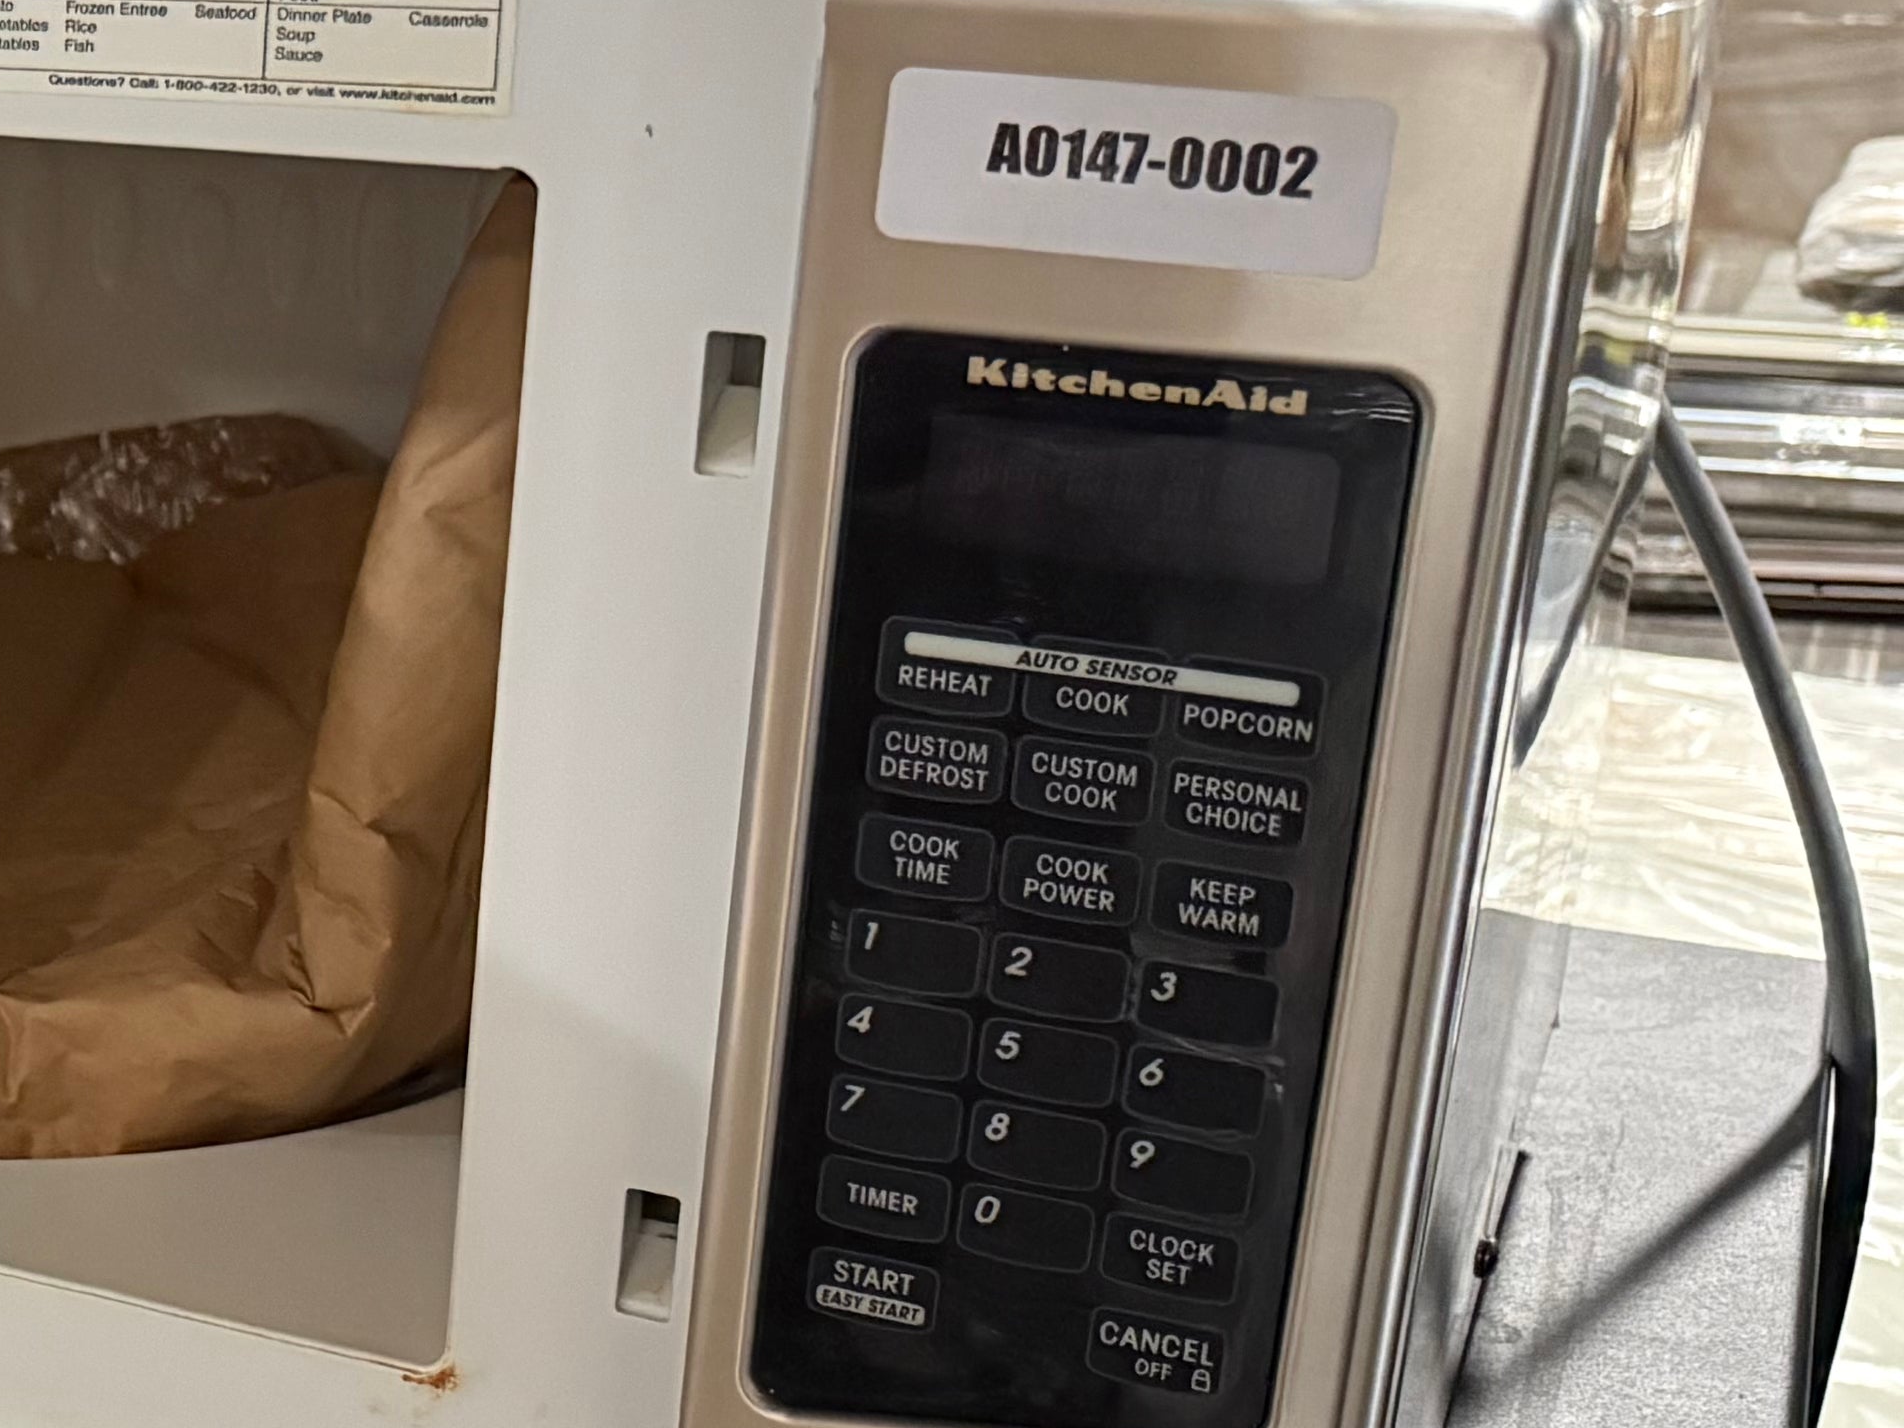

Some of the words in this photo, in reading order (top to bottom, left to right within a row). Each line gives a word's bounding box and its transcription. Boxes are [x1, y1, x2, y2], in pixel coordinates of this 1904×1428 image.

[65, 0, 116, 16] Frozen
[119, 1, 168, 18] Entree
[194, 4, 258, 21] Seafood
[277, 6, 328, 23] Dinner
[332, 9, 372, 25] Plate
[408, 11, 490, 29] Casserole
[64, 19, 98, 35] Rice
[276, 26, 316, 44] Soup
[64, 39, 95, 53] Fish
[274, 45, 324, 63] Sauce
[49, 74, 125, 89] Questions?
[286, 87, 302, 97] or
[306, 86, 335, 99] visit
[986, 122, 1319, 200] A0147-0002
[966, 355, 1309, 417] KitchenAid
[898, 664, 993, 698] REHEAT
[1016, 649, 1079, 673] AUTO
[1085, 658, 1178, 687] SENSOR
[1055, 685, 1130, 717] COOK
[1183, 703, 1313, 744] POPCORN
[884, 729, 989, 765] CUSTOM
[878, 753, 989, 793] DEFROST
[1031, 750, 1138, 788] CUSTOM
[1044, 781, 1117, 812] COOK
[1173, 771, 1303, 814] PERSONAL
[1185, 802, 1282, 837] CHOICE
[889, 829, 961, 861] COOK
[894, 855, 952, 886] TIME
[1036, 853, 1110, 885] COOK
[1022, 877, 1115, 913] POWER
[1190, 877, 1257, 908] KEEP
[864, 921, 880, 951] 1
[1178, 903, 1260, 938] WARM
[1004, 946, 1033, 976] 2
[1149, 971, 1178, 1003] 3
[846, 1005, 874, 1034] 4
[995, 1031, 1023, 1060] 5
[1138, 1058, 1165, 1087] 6
[840, 1084, 866, 1113] 7
[984, 1112, 1011, 1142] 8
[1128, 1140, 1156, 1169] 9
[846, 1181, 919, 1216] TIMER
[974, 1195, 1001, 1224] 0
[1129, 1229, 1215, 1267] CLOCK
[833, 1259, 915, 1296] START
[1146, 1259, 1190, 1286] SET
[821, 1287, 864, 1310] EASY
[867, 1297, 922, 1322] START
[1099, 1320, 1214, 1367] CANCEL
[1134, 1357, 1173, 1381] OFF
